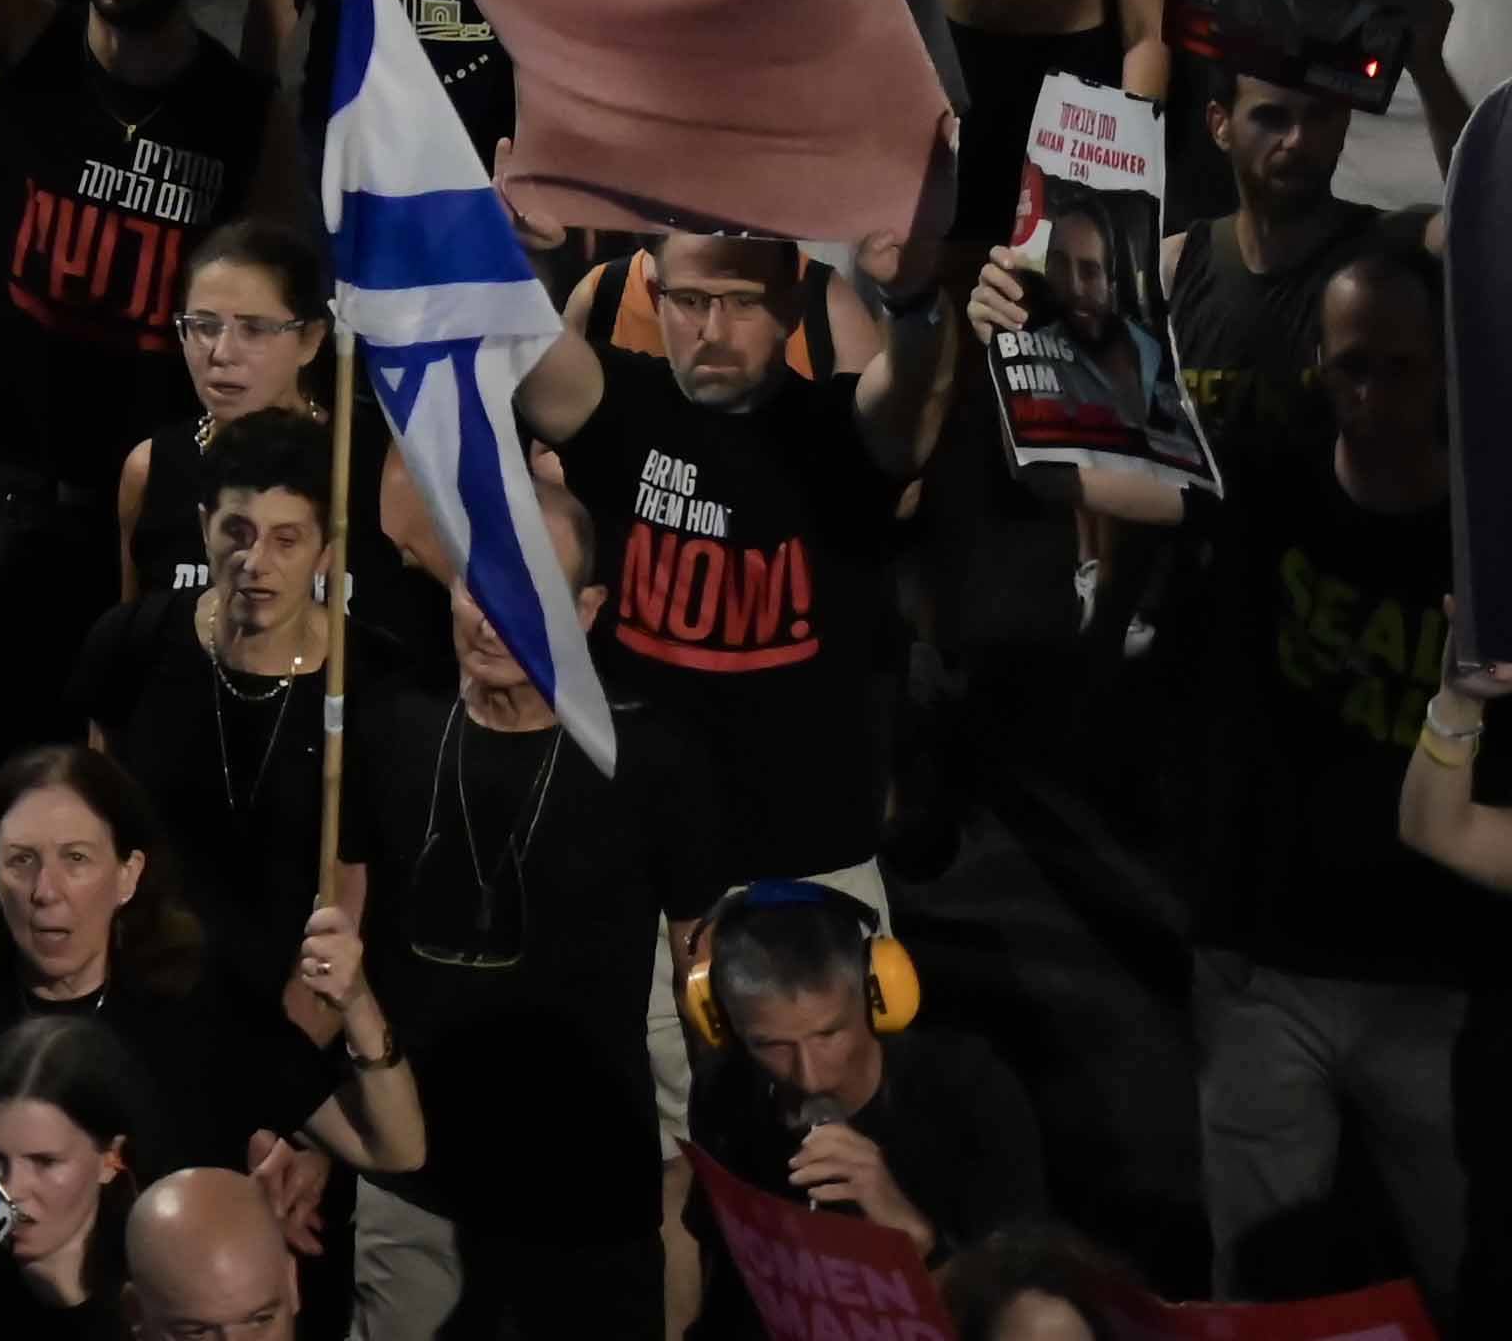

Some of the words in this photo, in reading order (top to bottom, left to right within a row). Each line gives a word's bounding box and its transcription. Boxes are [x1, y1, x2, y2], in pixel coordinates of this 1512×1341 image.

[1068, 137, 1146, 177] ZANGAUKER
[1068, 163, 1090, 182] (24)
[77, 159, 154, 215] הביתה
[996, 330, 1076, 363] BRING
[1004, 363, 1062, 394] HIM
[633, 481, 683, 529] THEM
[619, 521, 813, 647] NOW!
